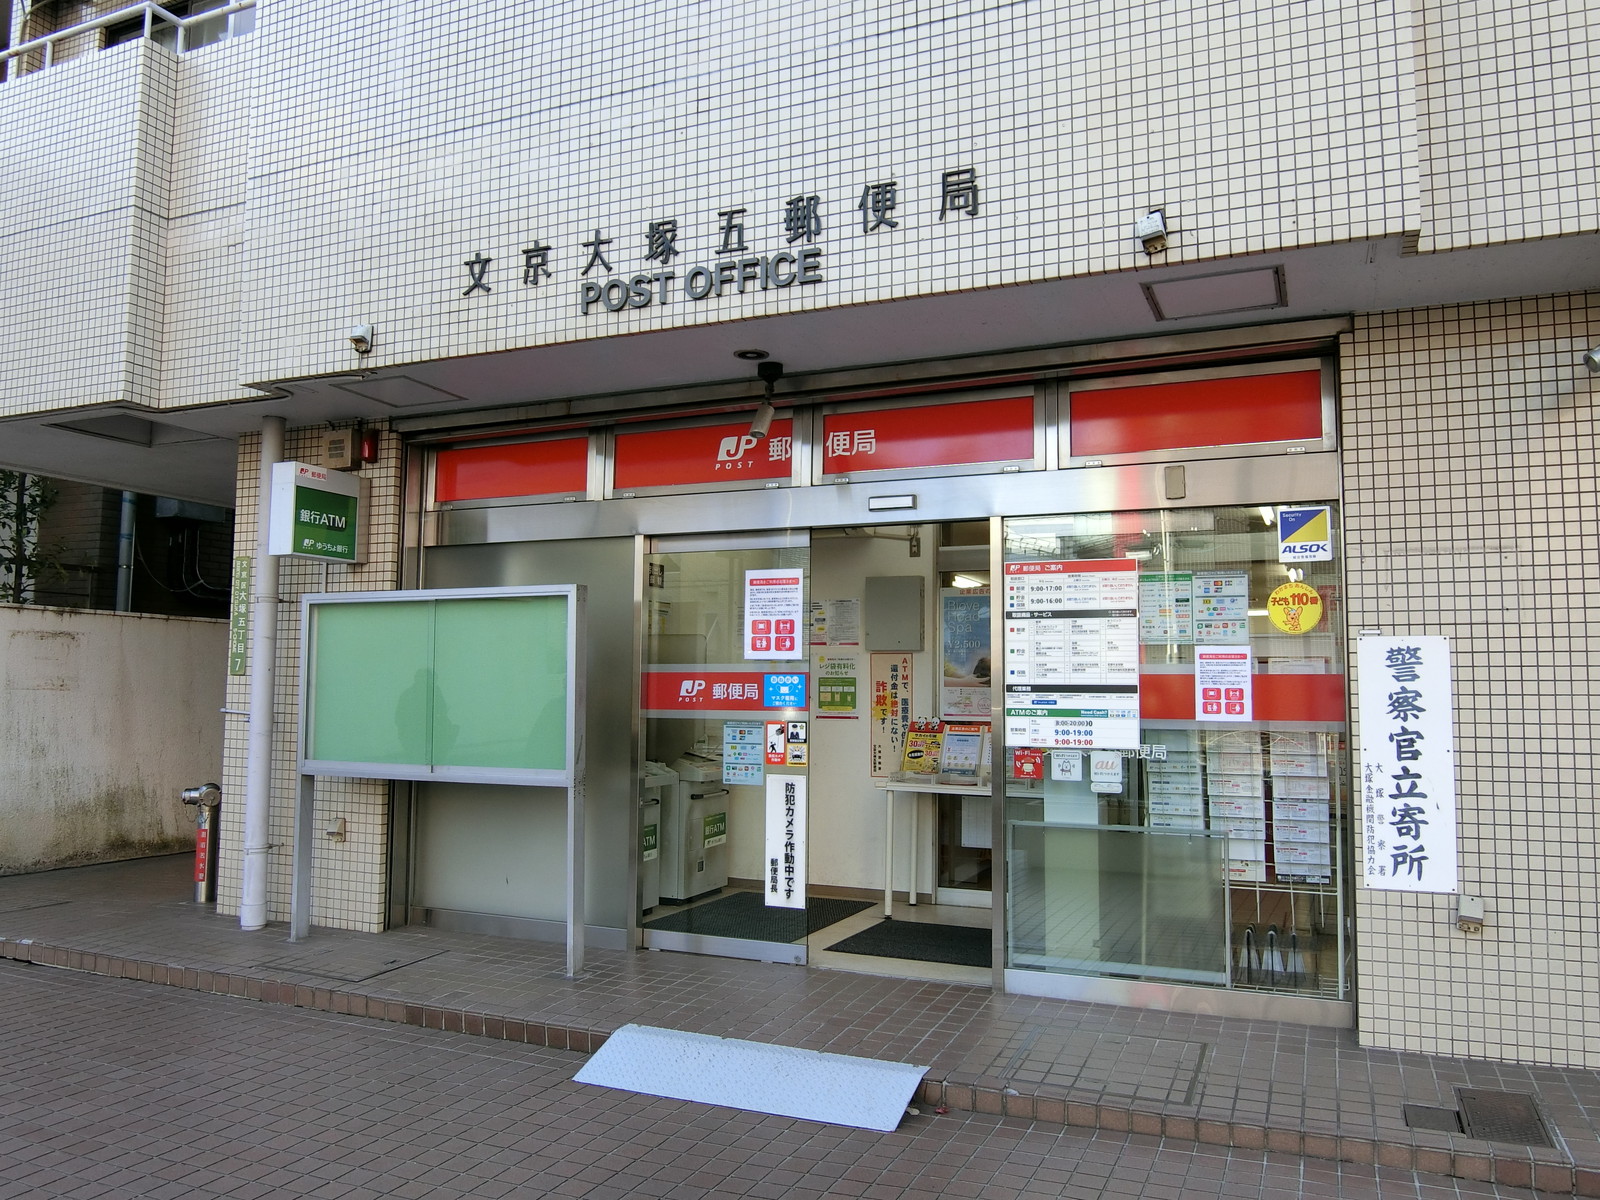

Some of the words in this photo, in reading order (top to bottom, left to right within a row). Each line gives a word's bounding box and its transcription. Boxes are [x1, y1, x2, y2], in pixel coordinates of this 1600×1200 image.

[462, 167, 979, 297] 文京大塚五郵便局
[581, 270, 675, 315] POST
[684, 246, 823, 301] OFFICE
[715, 461, 753, 471] POST
[300, 508, 346, 529] 銀行ATM
[316, 542, 349, 554] ゆうちょ銀行
[1282, 543, 1328, 554] ALSOK
[948, 621, 973, 635] Spa
[235, 658, 242, 671] 7
[712, 683, 759, 701] 郵便局
[1095, 760, 1119, 770] au
[1385, 646, 1430, 882] 警察官立寄所
[1375, 762, 1386, 876] 大塚警察署
[784, 782, 796, 900] 防犯カメラ作動中です
[770, 857, 779, 894] 郵便局長
